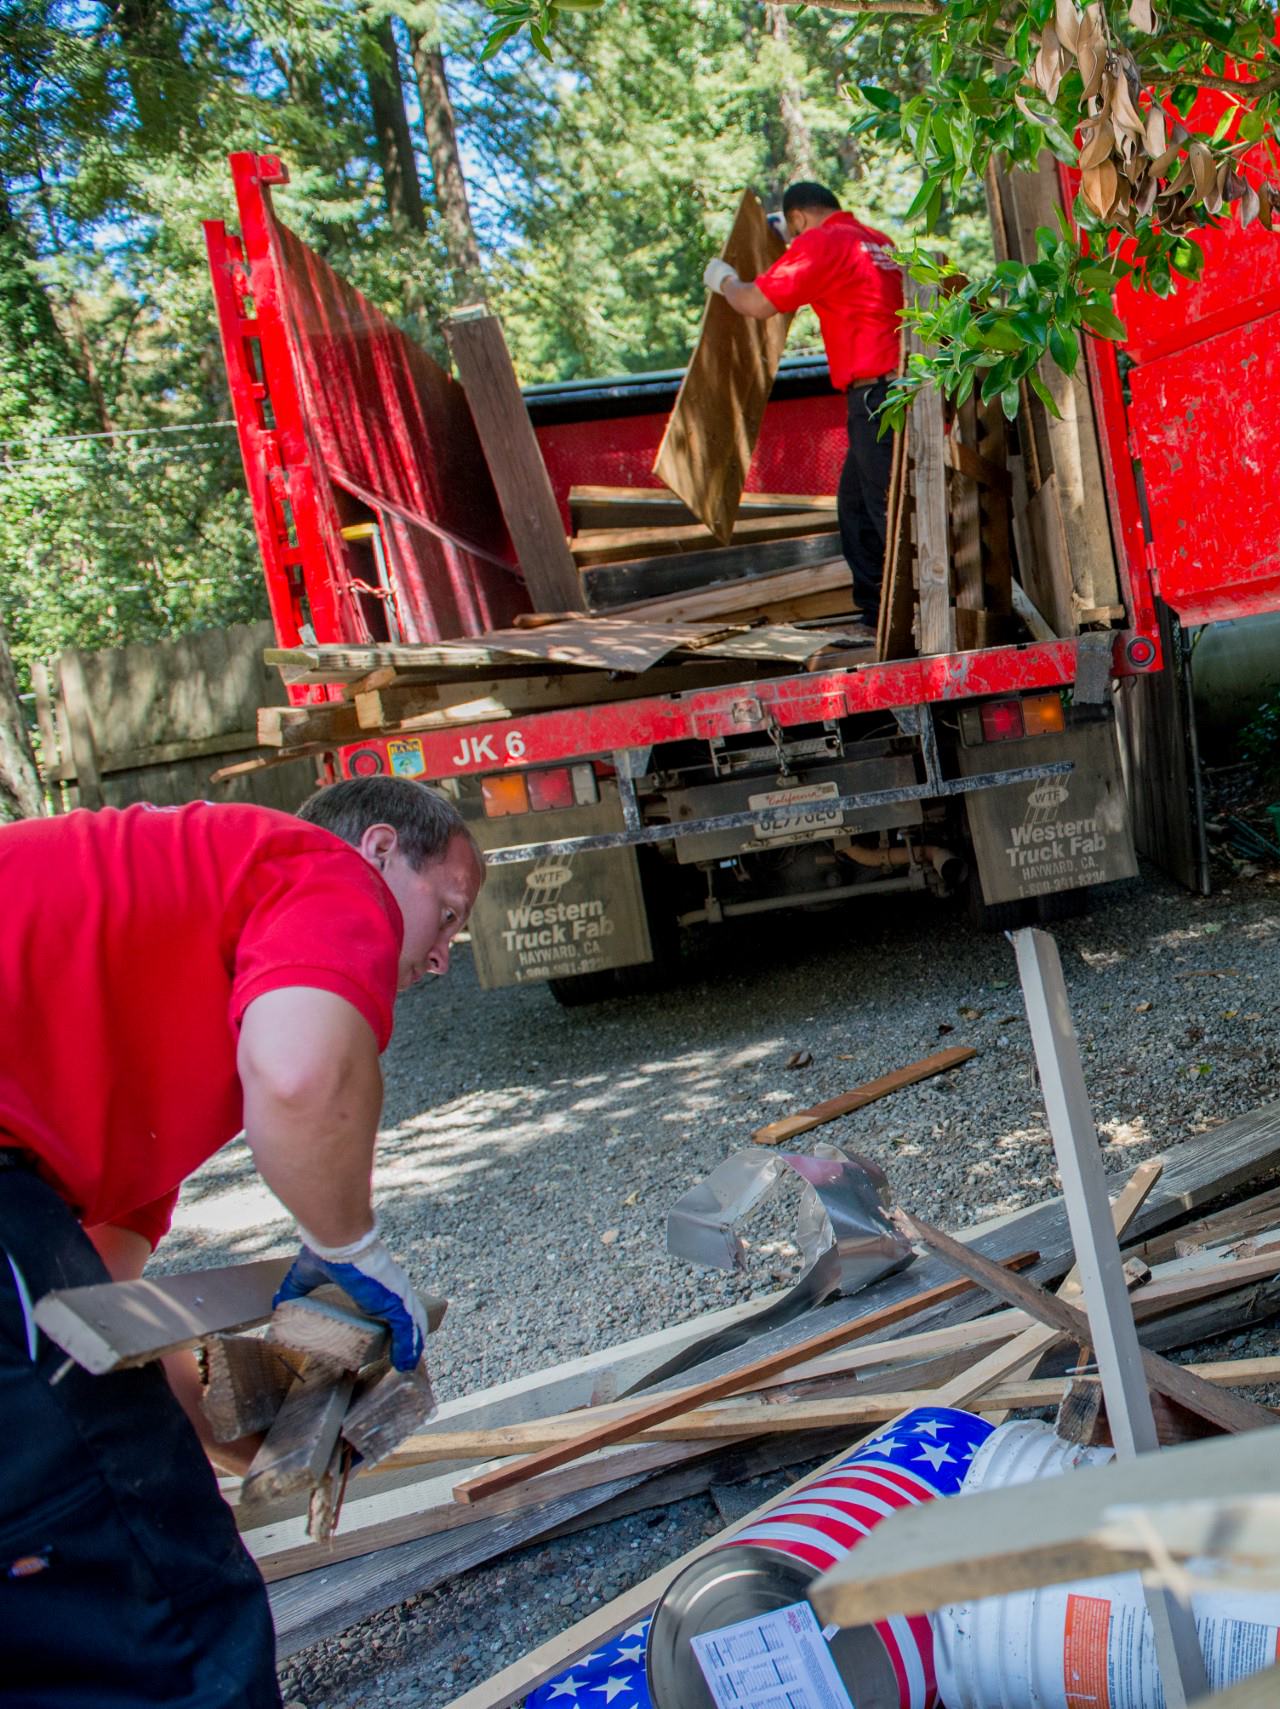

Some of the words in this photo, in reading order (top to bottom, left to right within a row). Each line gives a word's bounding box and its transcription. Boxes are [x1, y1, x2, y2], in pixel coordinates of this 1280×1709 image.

[452, 734, 499, 766] JK
[505, 730, 525, 758] 6
[1034, 790, 1062, 803] WTF
[1010, 818, 1097, 846] Western
[1005, 841, 1065, 868] Truck
[1070, 832, 1106, 856] Fab
[535, 871, 562, 884] WTF
[1022, 859, 1079, 881] HAYWARD,
[507, 899, 603, 930] Western
[502, 924, 566, 952] Truck
[573, 915, 614, 941] Fab
[519, 944, 581, 966] HAYWARD,
